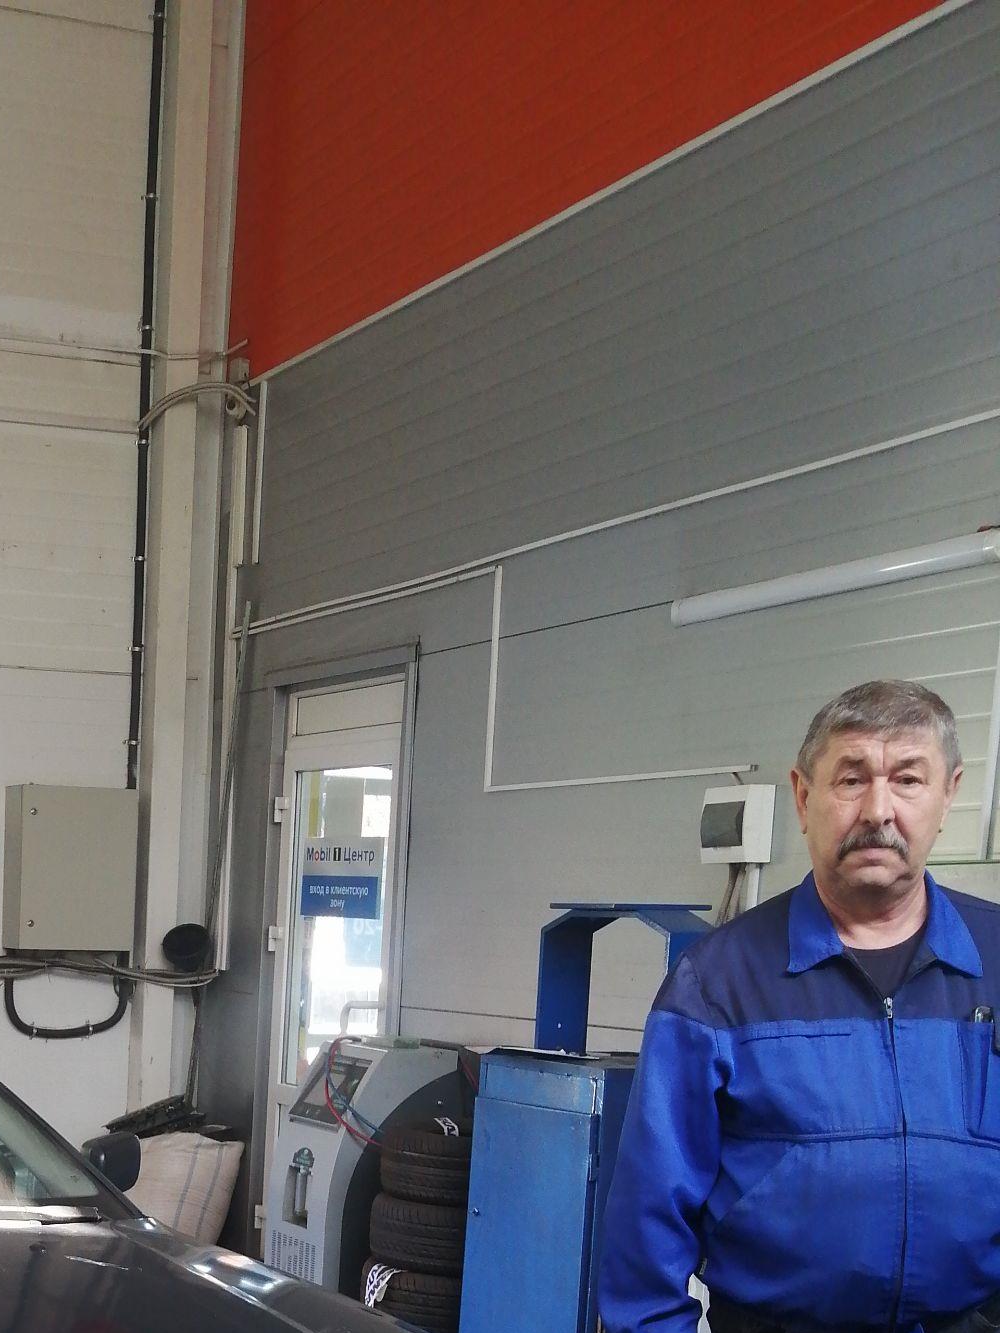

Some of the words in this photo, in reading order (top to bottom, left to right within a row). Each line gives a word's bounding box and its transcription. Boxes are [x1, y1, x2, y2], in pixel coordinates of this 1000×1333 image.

[306, 847, 331, 861] Mobil
[333, 847, 342, 862] 1
[343, 847, 375, 866] Центр
[309, 885, 325, 896] вход
[330, 885, 369, 899] клиентскую
[329, 899, 345, 911] зону
